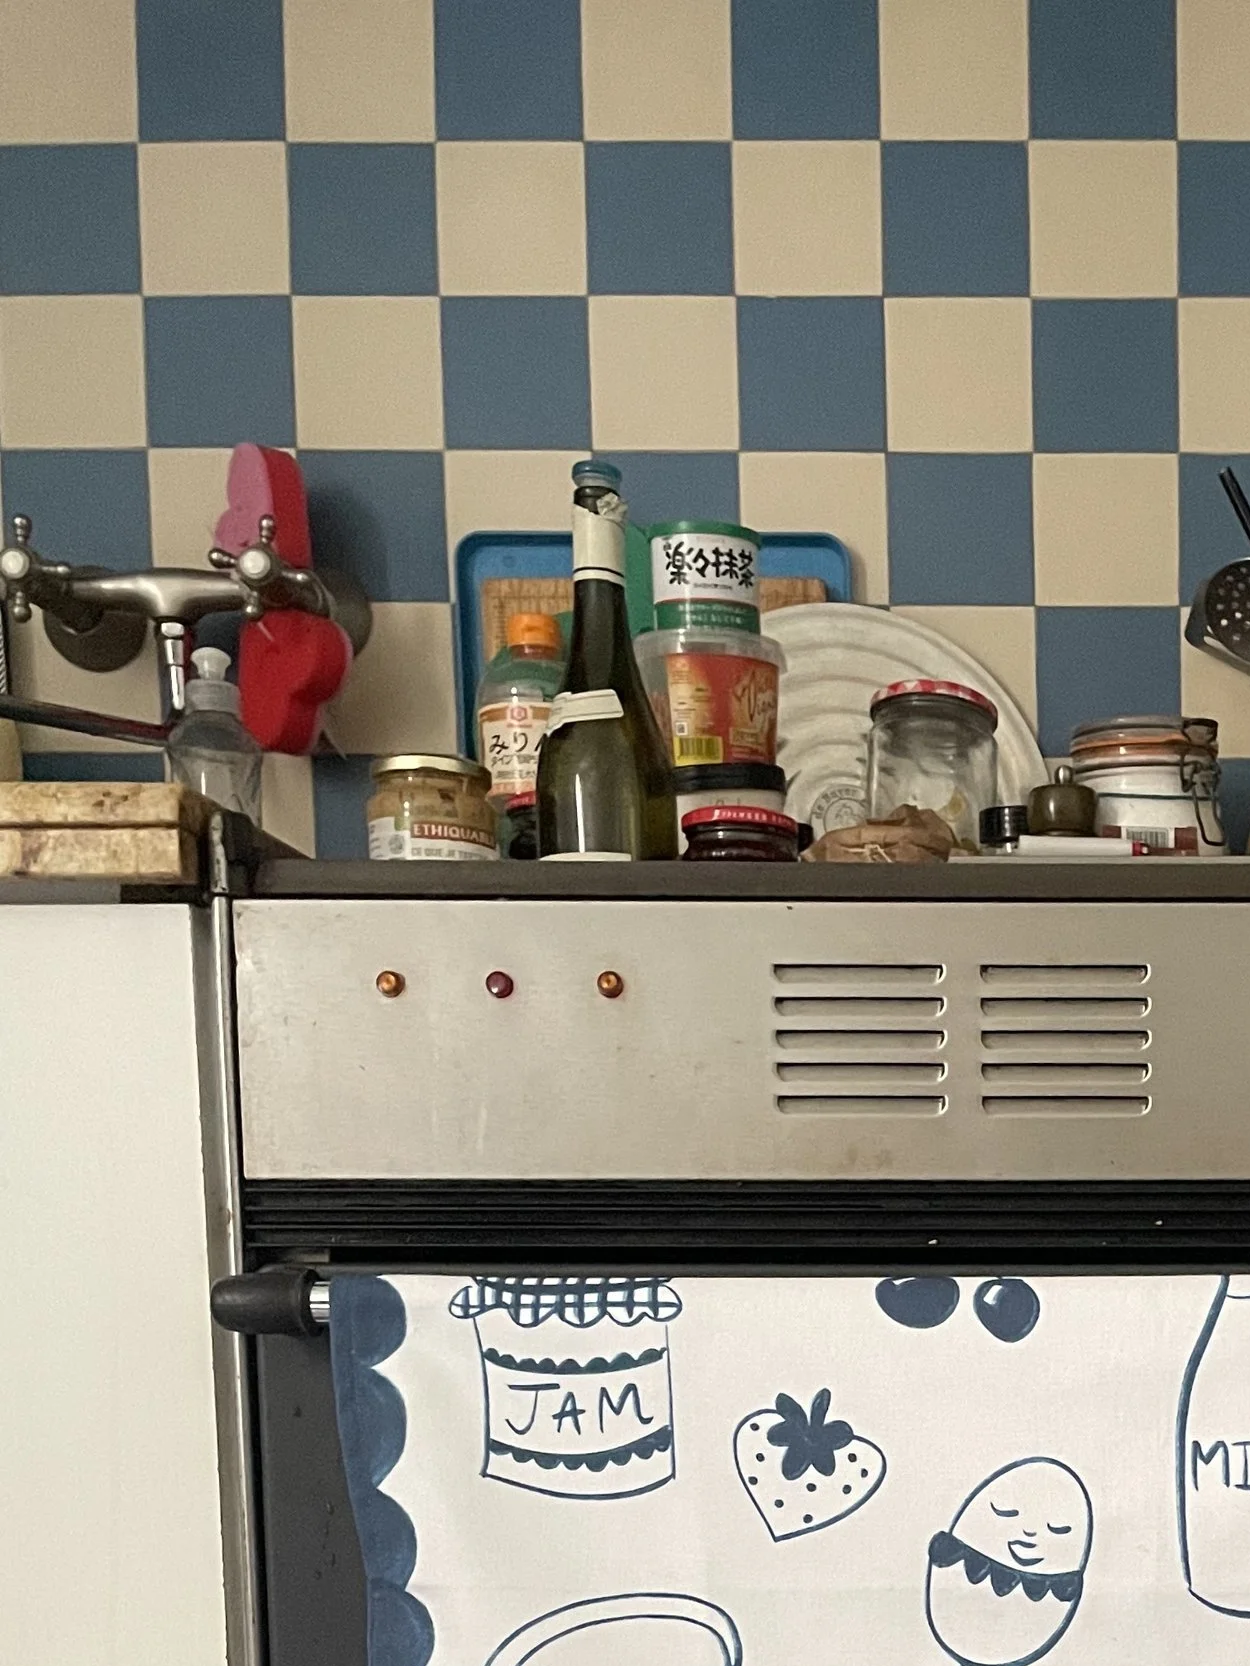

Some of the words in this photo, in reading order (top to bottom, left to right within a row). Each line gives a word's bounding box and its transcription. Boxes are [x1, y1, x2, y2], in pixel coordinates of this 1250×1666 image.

[665, 541, 755, 588] 楽々抹茶
[504, 1380, 655, 1437] JAM
